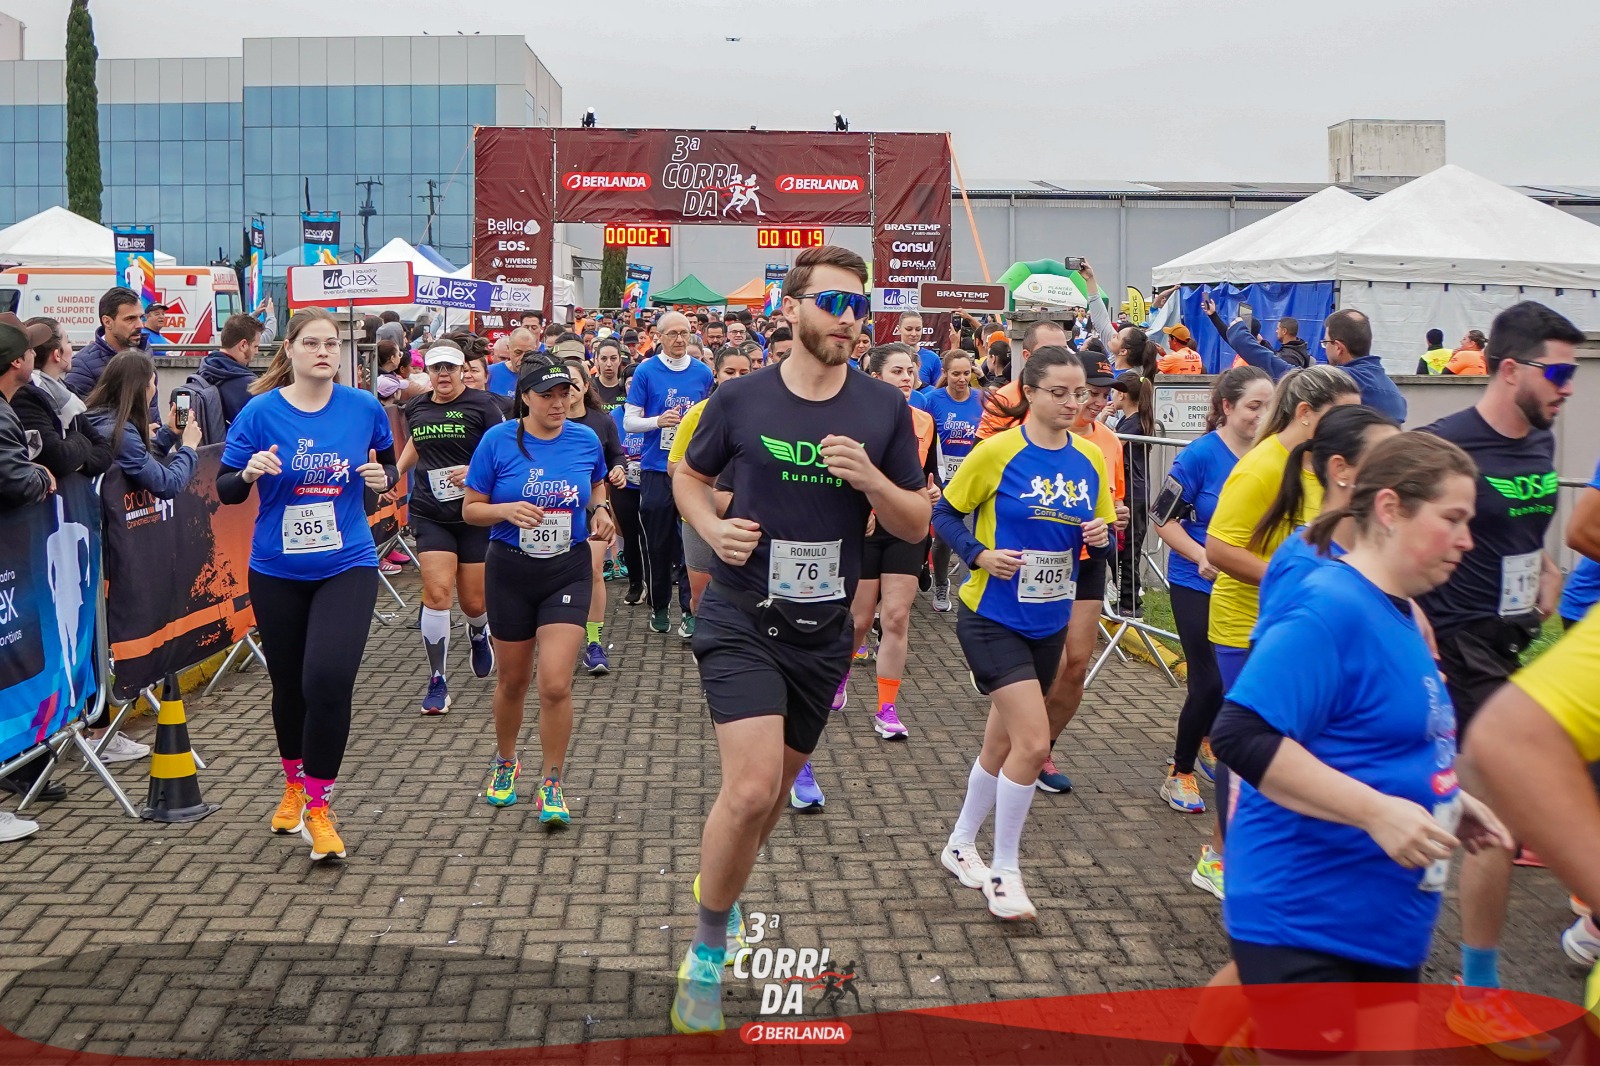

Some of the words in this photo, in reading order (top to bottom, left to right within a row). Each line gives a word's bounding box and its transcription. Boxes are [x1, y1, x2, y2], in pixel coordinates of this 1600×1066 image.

[582, 175, 647, 188] BERLANDA
[662, 163, 739, 189] CORRI
[795, 178, 859, 191] BERLANDA
[682, 190, 718, 217] DA
[487, 217, 525, 232] Bella
[884, 223, 941, 231] BRASTEMP
[605, 226, 670, 245] 000027
[498, 240, 530, 251] EOS.
[892, 241, 934, 253] Consul
[504, 257, 538, 265] VIVENSIS
[902, 260, 936, 269] BRASLAR
[323, 269, 378, 290] dialex
[418, 278, 477, 302] dialex
[936, 290, 990, 299] BRASTEMP
[57, 295, 95, 303] UNIDADE
[883, 289, 918, 306] diale
[442, 301, 476, 309] esportivos
[53, 316, 94, 325] VANÇADO
[163, 316, 186, 328] TAR
[1176, 393, 1211, 402] ATENÇ
[412, 424, 466, 438] RUNNER
[668, 432, 675, 441] 2
[291, 453, 338, 471] CORRI
[947, 463, 960, 472] 50
[303, 469, 326, 485] DA
[781, 471, 843, 487] Running
[306, 486, 339, 495] BERLANDA
[439, 480, 453, 490] 52
[522, 480, 567, 498] CORRI
[301, 509, 315, 518] LEA
[293, 520, 323, 536] 365
[541, 518, 558, 526] RUNA
[532, 529, 558, 542] 361
[790, 547, 827, 557] ROMULO
[795, 563, 819, 581] 76
[1034, 569, 1064, 584] 405
[0, 629, 23, 647] ortivos
